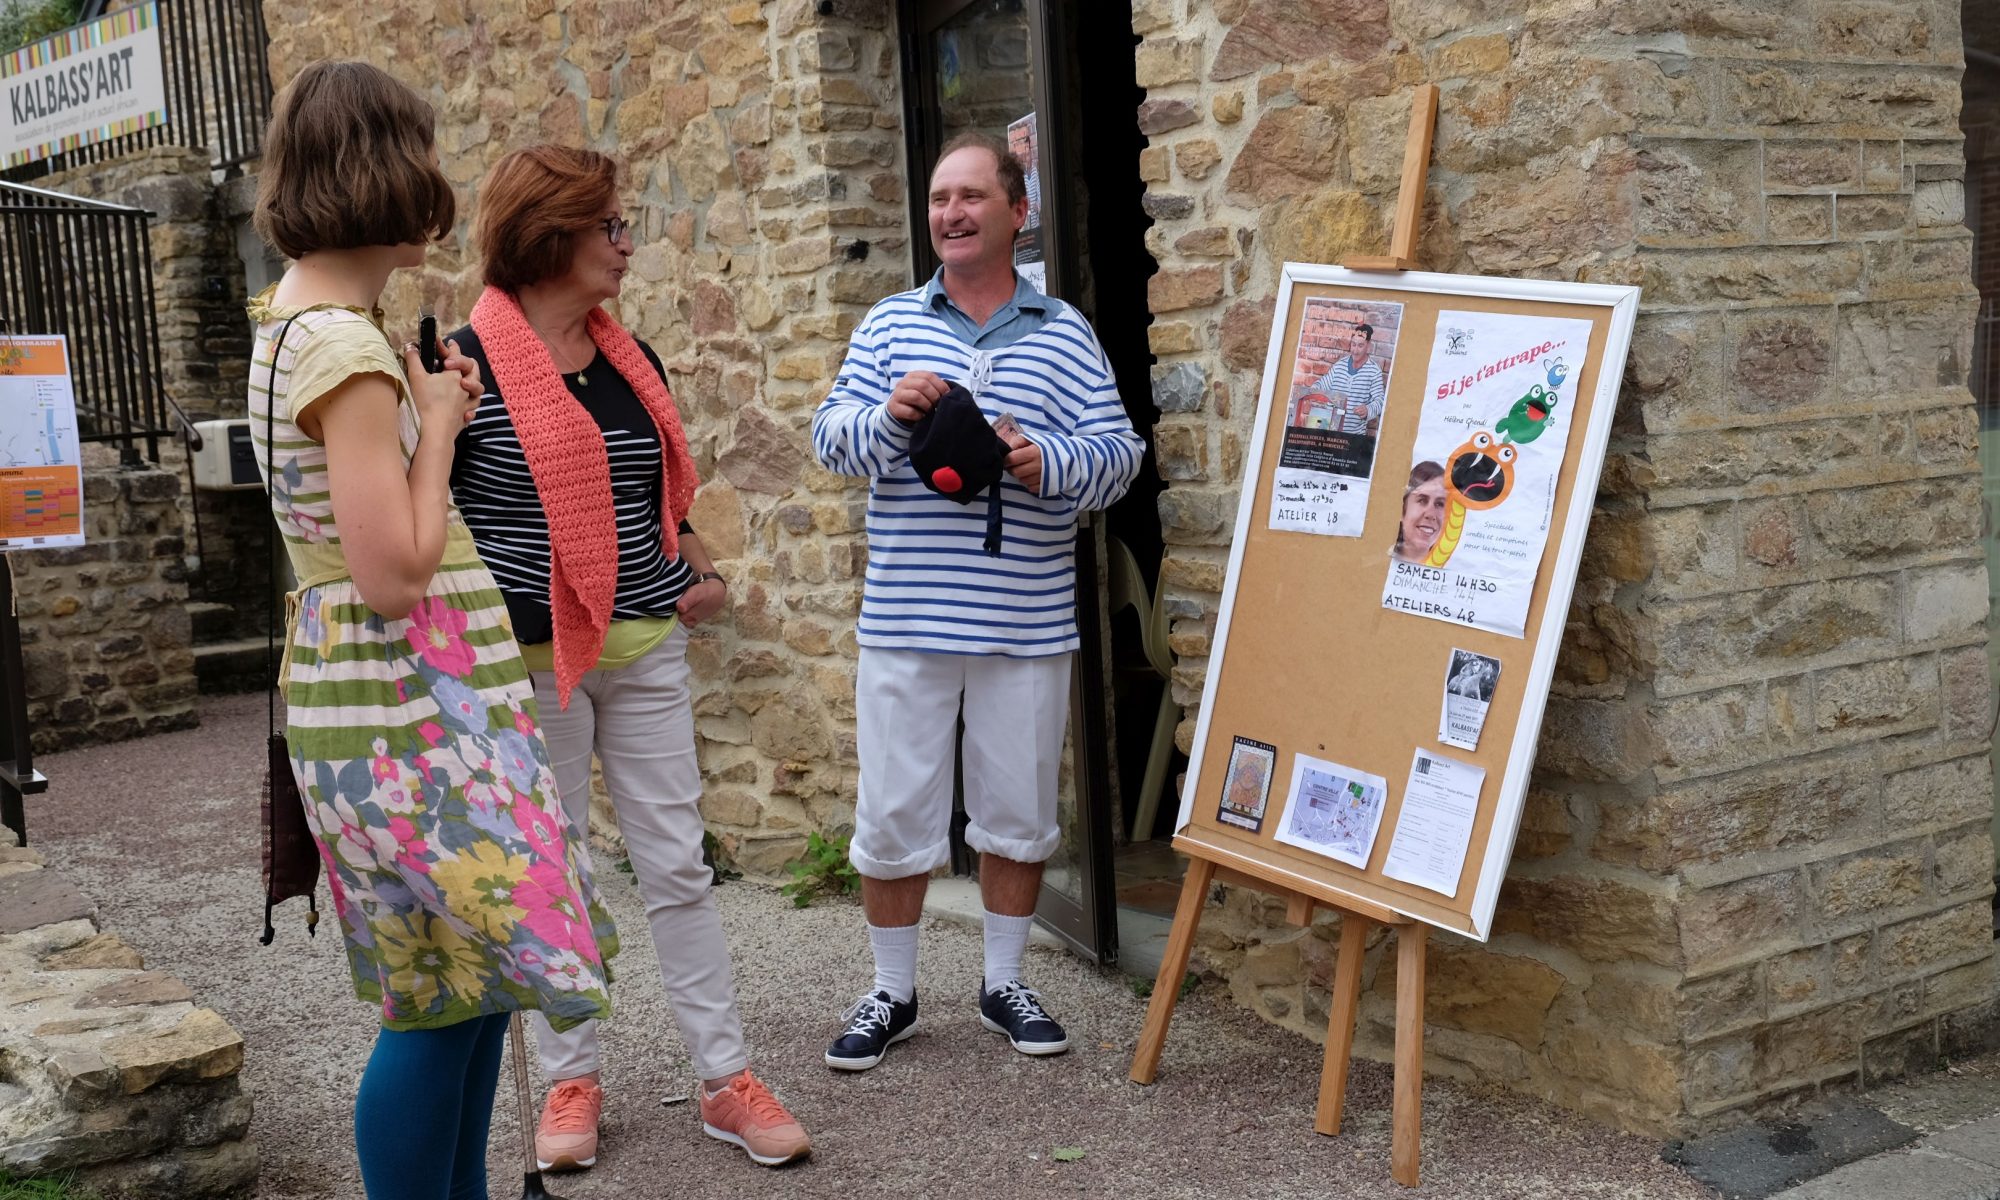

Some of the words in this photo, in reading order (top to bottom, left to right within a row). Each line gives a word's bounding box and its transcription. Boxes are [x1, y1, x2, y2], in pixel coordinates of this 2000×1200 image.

[10, 47, 133, 126] KALBASS'ART
[1437, 380, 1456, 400] Si
[1457, 374, 1474, 395] je
[1393, 575, 1448, 595] DIMANCHE
[1396, 563, 1446, 583] SAMEDI
[1384, 594, 1451, 618] ATELIERS
[1457, 608, 1475, 623] 48
